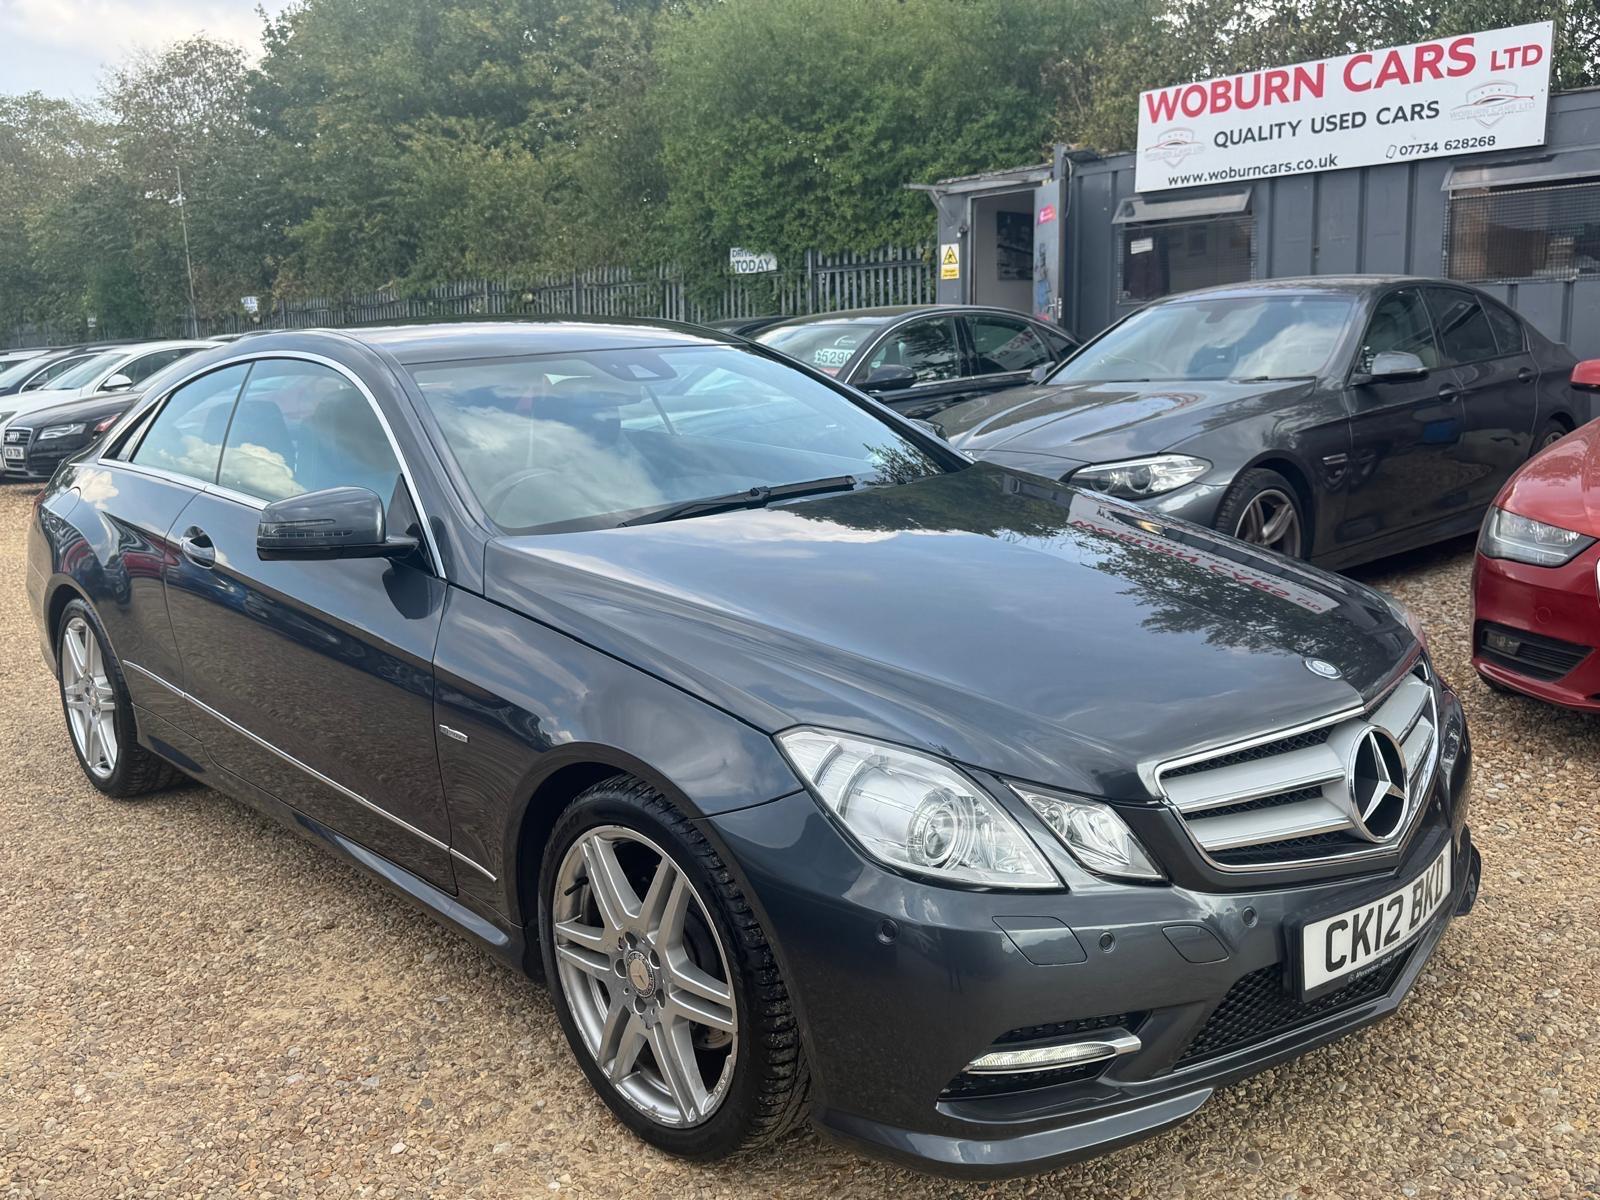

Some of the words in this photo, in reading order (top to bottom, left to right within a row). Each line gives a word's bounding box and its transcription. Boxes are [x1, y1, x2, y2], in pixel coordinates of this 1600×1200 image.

[1145, 63, 1325, 123] WOBURN
[1343, 37, 1476, 92] CARS
[1490, 44, 1543, 71] LTD
[1214, 120, 1302, 148] QUALITY
[1311, 111, 1366, 134] USED
[1376, 100, 1440, 125] CARS
[1399, 142, 1438, 156] 07734
[1444, 135, 1496, 151] 628268
[1168, 153, 1338, 186] www.woburncars.co.uk
[735, 258, 772, 273] TODAY
[1325, 894, 1404, 973] CK12
[1409, 854, 1444, 931] BKD
